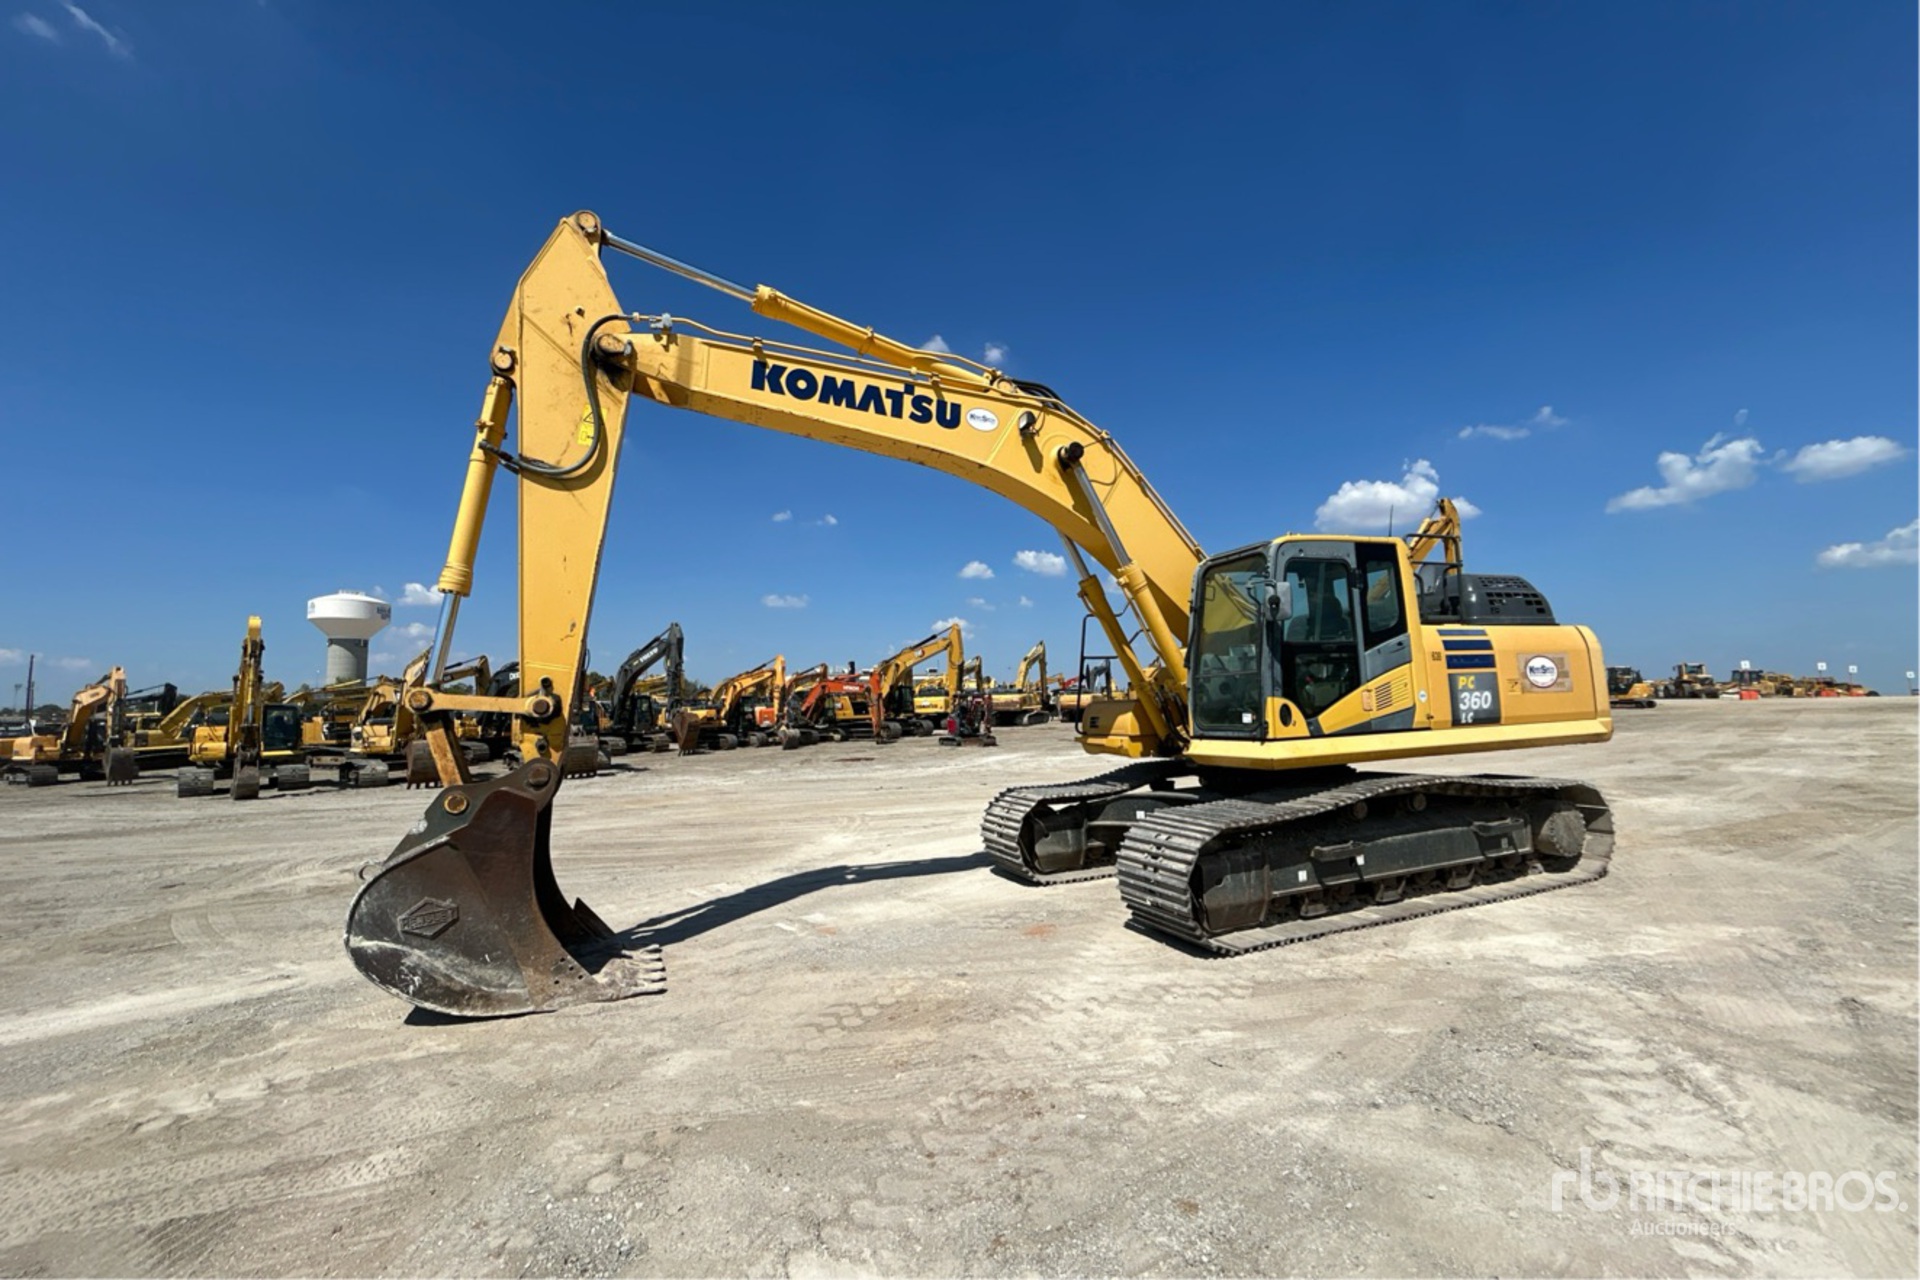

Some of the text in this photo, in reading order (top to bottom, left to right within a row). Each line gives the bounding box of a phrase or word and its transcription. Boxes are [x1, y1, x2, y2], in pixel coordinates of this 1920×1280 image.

[751, 359, 961, 430] KOMATSU
[1458, 676, 1475, 690] PC
[1460, 690, 1492, 710] 360
[1461, 712, 1475, 723] LC
